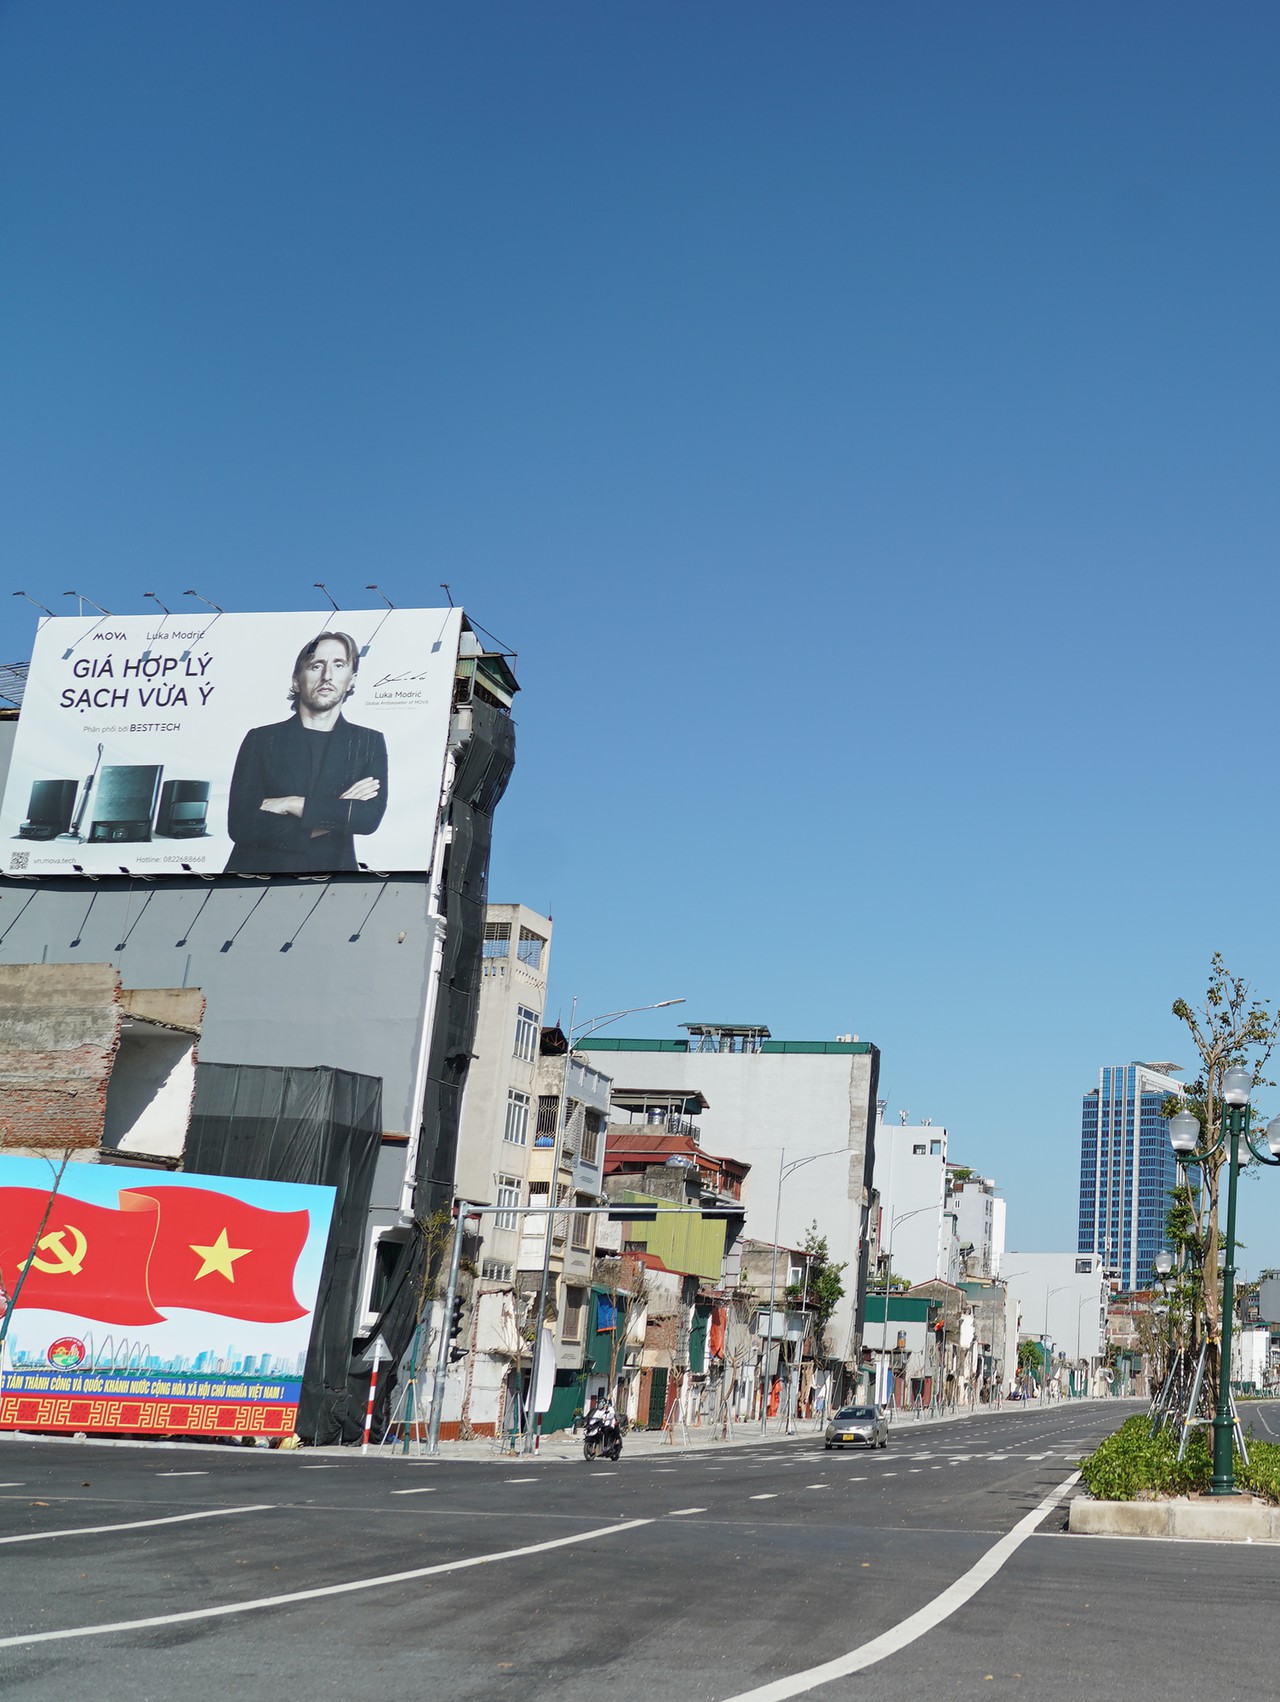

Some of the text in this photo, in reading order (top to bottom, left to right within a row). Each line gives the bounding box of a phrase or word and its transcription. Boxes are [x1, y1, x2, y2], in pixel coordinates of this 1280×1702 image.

[93, 632, 127, 640] MOVA
[146, 630, 206, 640] Luka Modrić
[73, 652, 213, 682] GIÁ HỢP LÝ
[60, 681, 215, 713] SẠCH VỪA Ý
[130, 723, 181, 732] BESTTECH
[6, 1373, 23, 1389] TÁM
[24, 1374, 49, 1390] THÀNH
[50, 1375, 71, 1391] CÔNG
[72, 1377, 82, 1392] VÀ
[83, 1375, 104, 1393] QUỐC
[104, 1377, 130, 1393] KHÁNH
[130, 1378, 150, 1394] NƯỚC
[150, 1379, 171, 1397] CỘNG
[187, 1381, 198, 1396] XÃ
[198, 1381, 210, 1399] HỘI
[211, 1381, 226, 1397] CHỦ
[226, 1382, 247, 1398] NGHĨA
[248, 1383, 263, 1400] VIỆT
[263, 1386, 280, 1399] NAM
